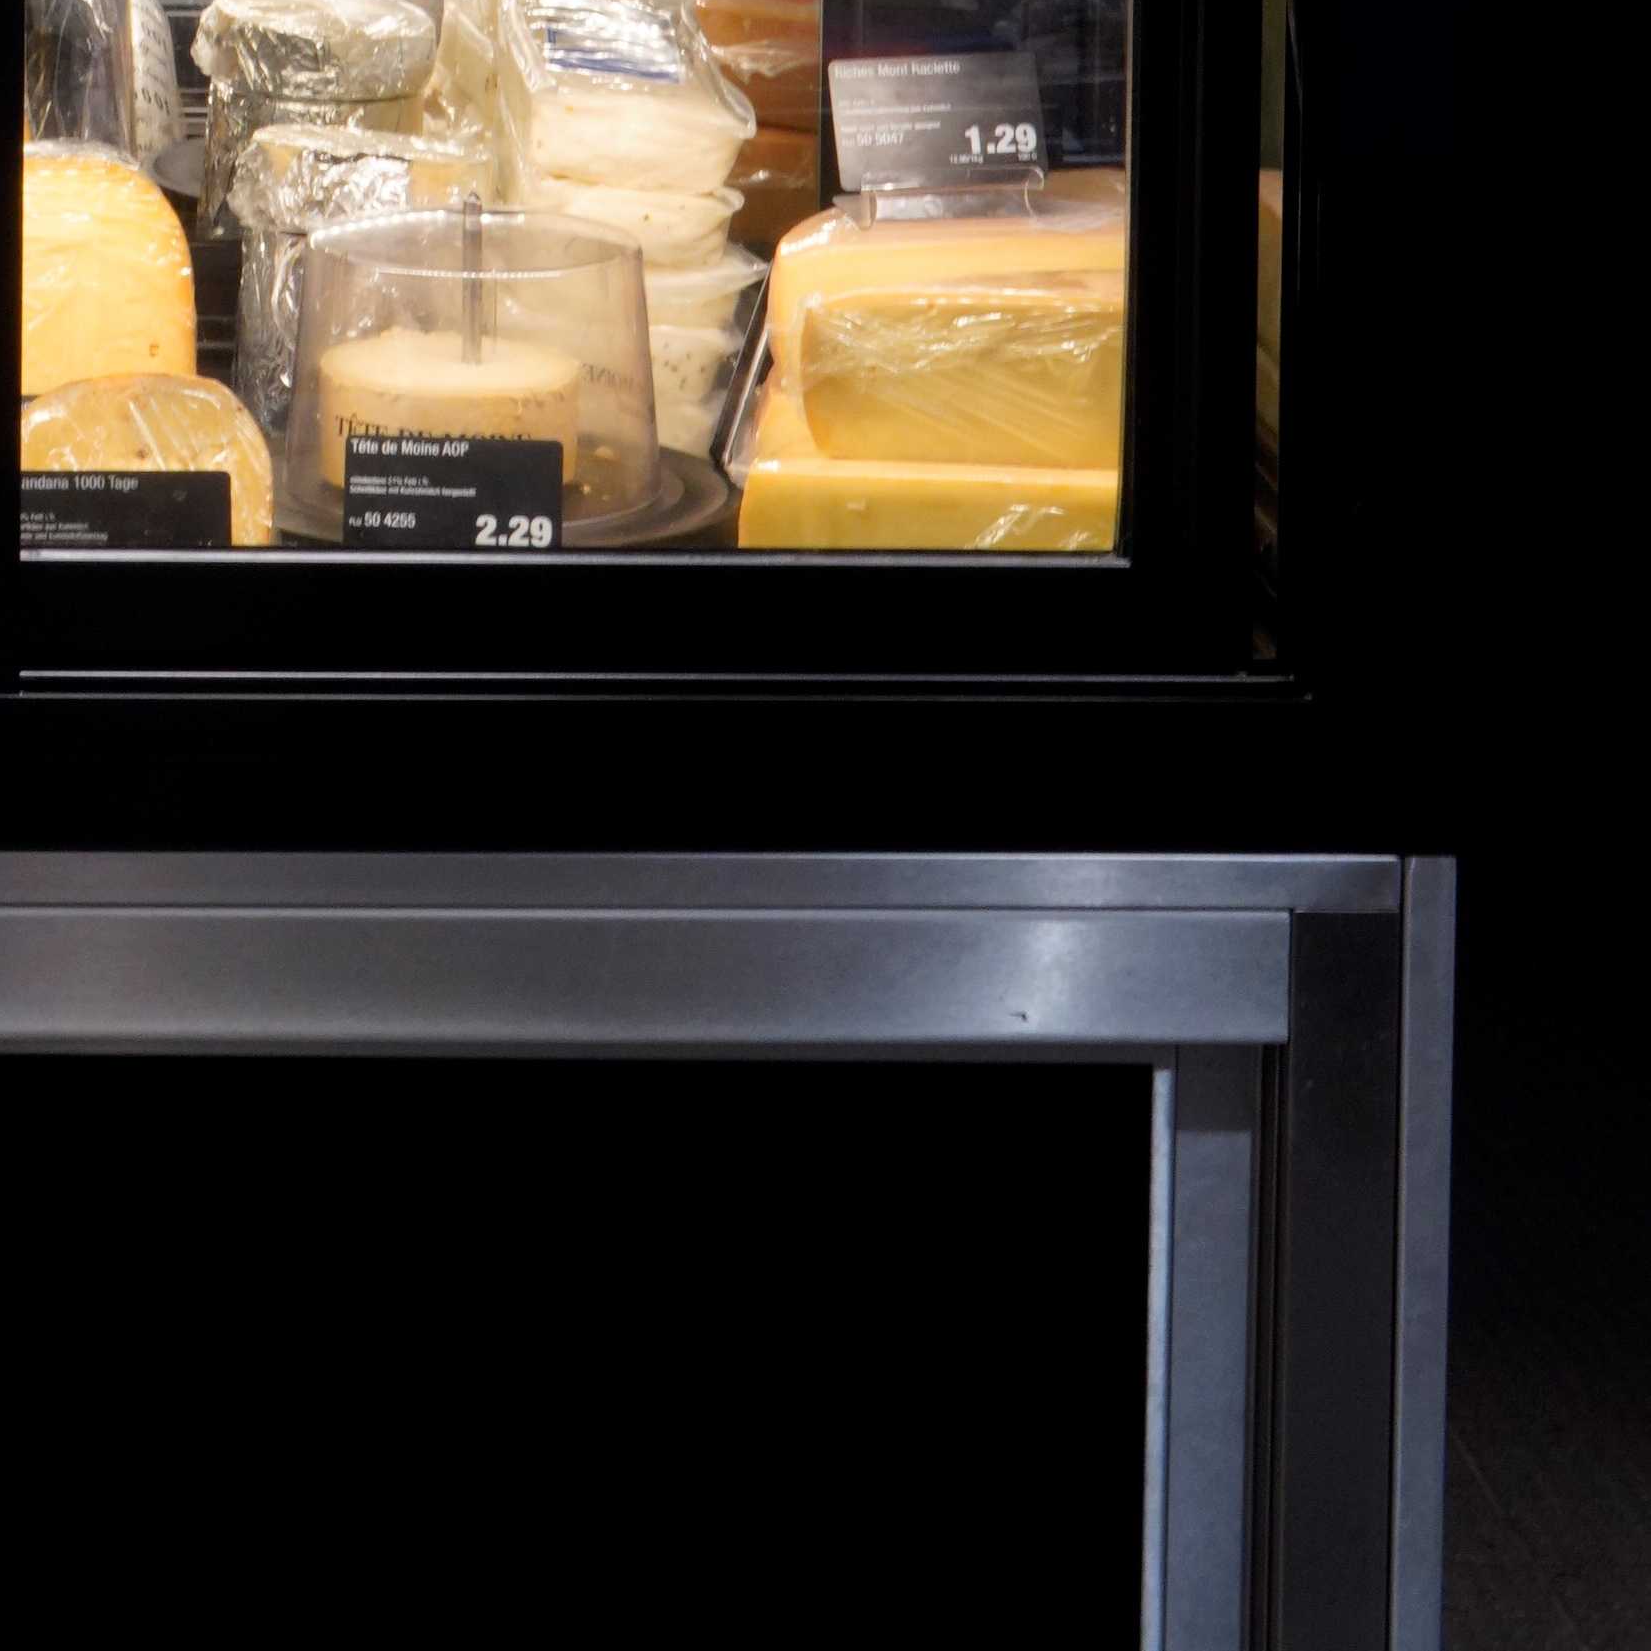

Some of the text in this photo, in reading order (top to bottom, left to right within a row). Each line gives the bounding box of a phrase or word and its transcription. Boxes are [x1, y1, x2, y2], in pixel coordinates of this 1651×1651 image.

[912, 62, 960, 75] Raclette
[965, 123, 1037, 154] 1.29
[351, 439, 469, 457] Tête de Moine AOP
[74, 476, 105, 490] 1000
[109, 475, 138, 492] Tage
[364, 512, 381, 527] 50
[475, 514, 553, 547] 2.29
